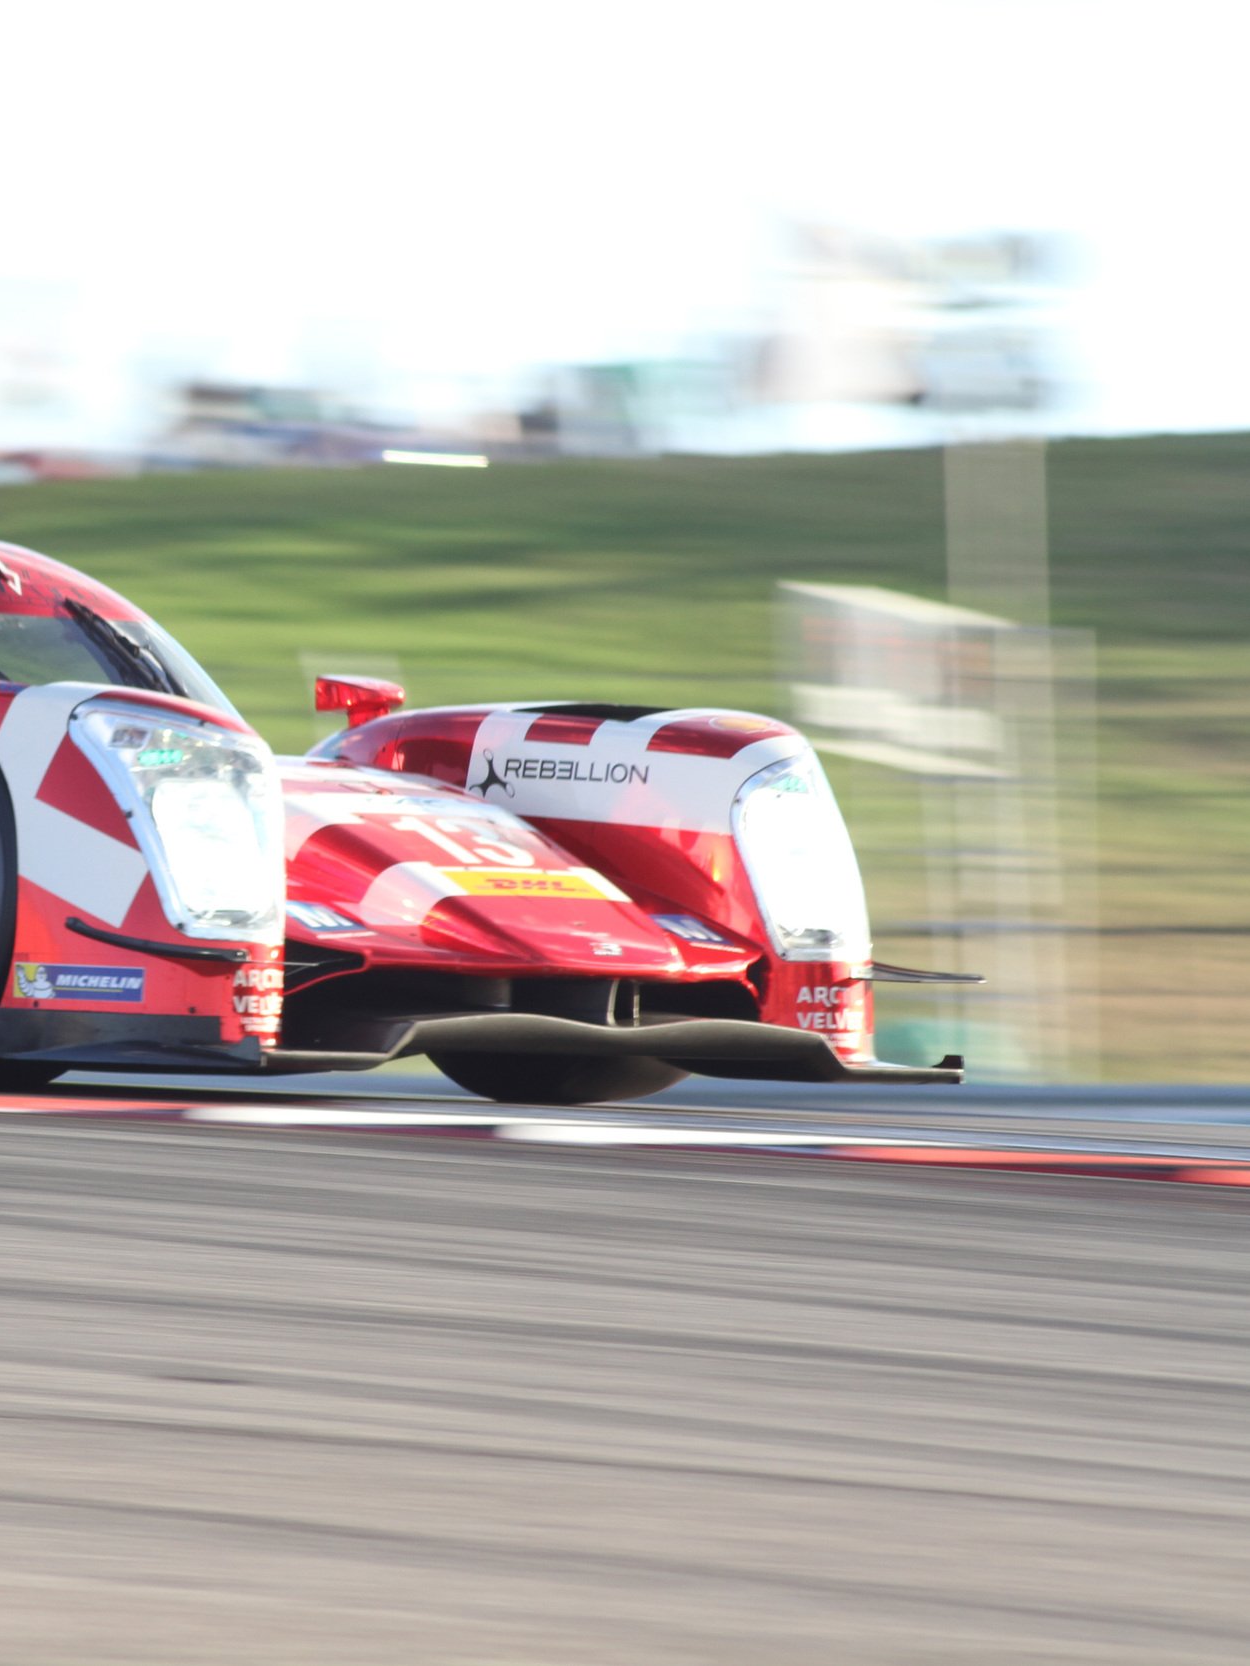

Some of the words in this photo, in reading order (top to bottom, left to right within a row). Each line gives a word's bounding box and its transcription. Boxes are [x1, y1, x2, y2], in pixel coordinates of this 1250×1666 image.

[504, 758, 650, 785] REBELLION
[389, 815, 535, 868] 13
[484, 877, 578, 893] DHL
[54, 973, 143, 990] MICHELIN
